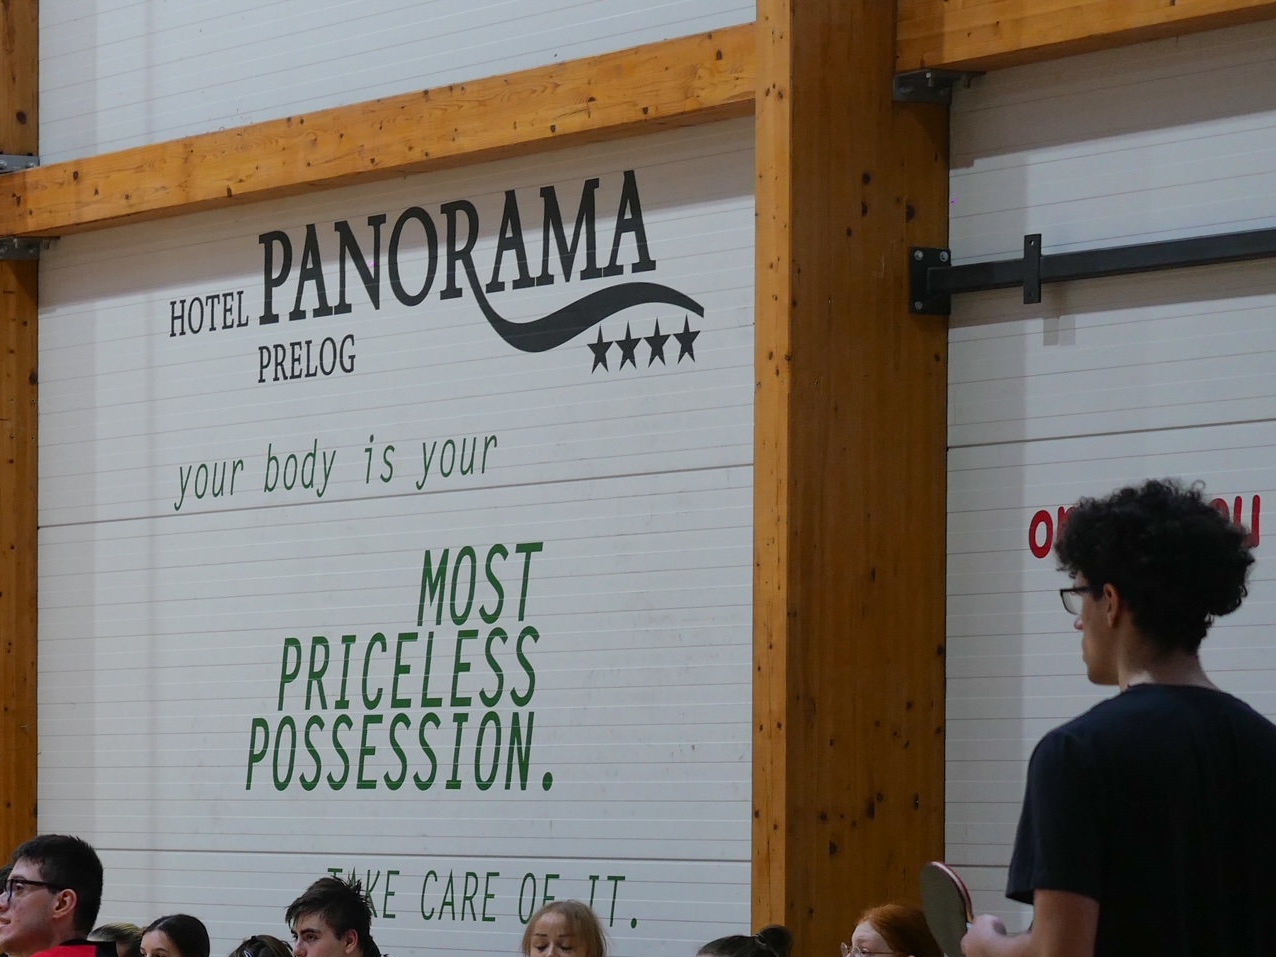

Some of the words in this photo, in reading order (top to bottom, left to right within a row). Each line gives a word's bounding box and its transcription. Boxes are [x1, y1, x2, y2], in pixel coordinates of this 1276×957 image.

[170, 291, 248, 336] HOTEL
[259, 170, 656, 325] PANORAMA
[258, 335, 356, 383] PRELOG
[175, 459, 244, 511] your
[264, 439, 336, 497] body
[365, 434, 395, 484] is
[416, 434, 498, 489] your
[417, 542, 543, 626] MOST
[278, 626, 540, 711] PRICELESS
[246, 711, 553, 791] POSSESSION.
[421, 868, 500, 922] CARE
[589, 874, 637, 929] IT.
